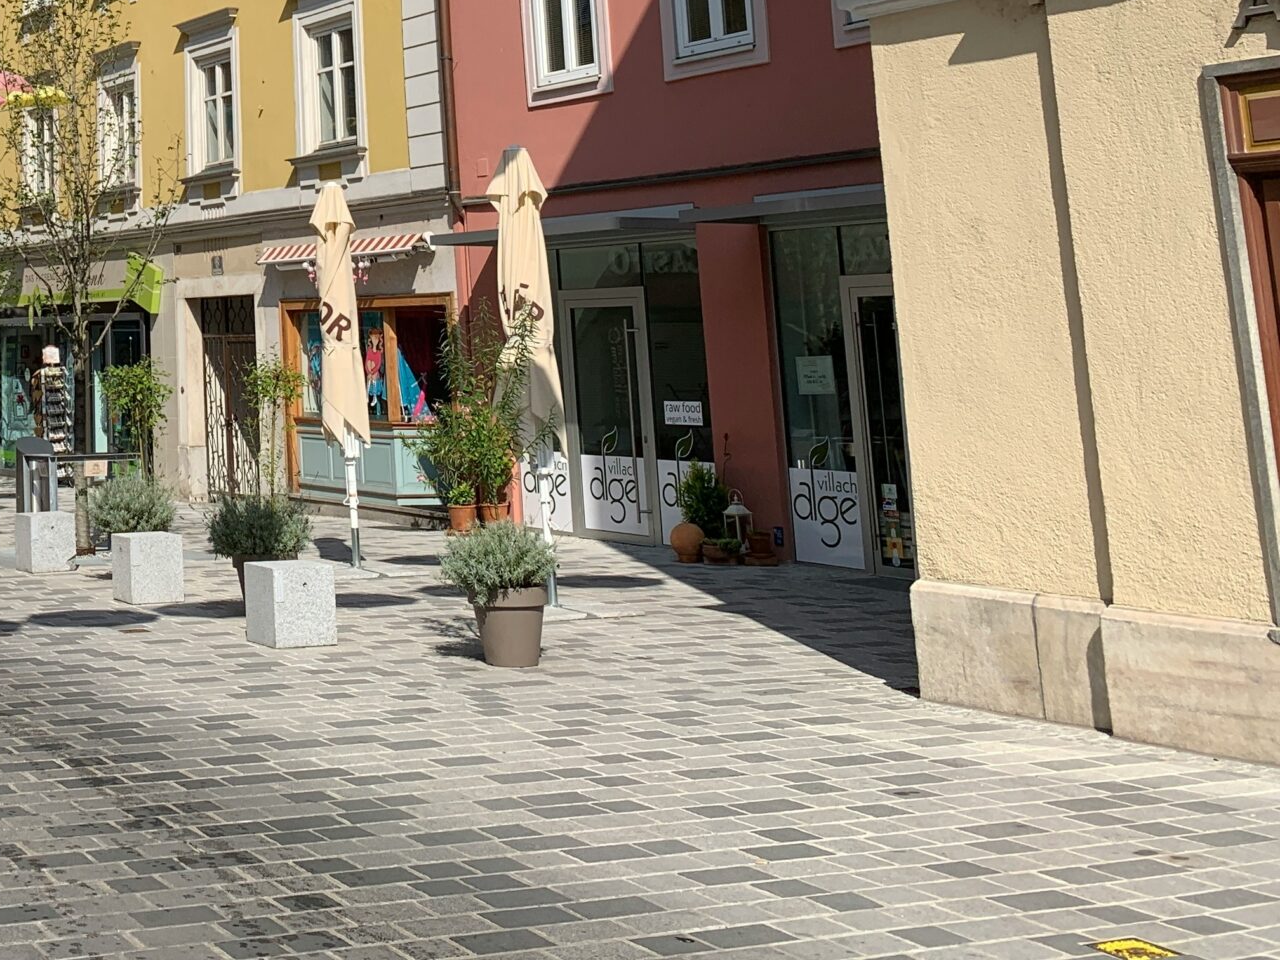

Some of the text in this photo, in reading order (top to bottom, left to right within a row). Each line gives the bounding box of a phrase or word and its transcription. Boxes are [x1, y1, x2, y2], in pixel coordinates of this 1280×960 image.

[665, 402, 701, 414] raw food
[817, 471, 858, 494] villach
[793, 478, 858, 548] alge
